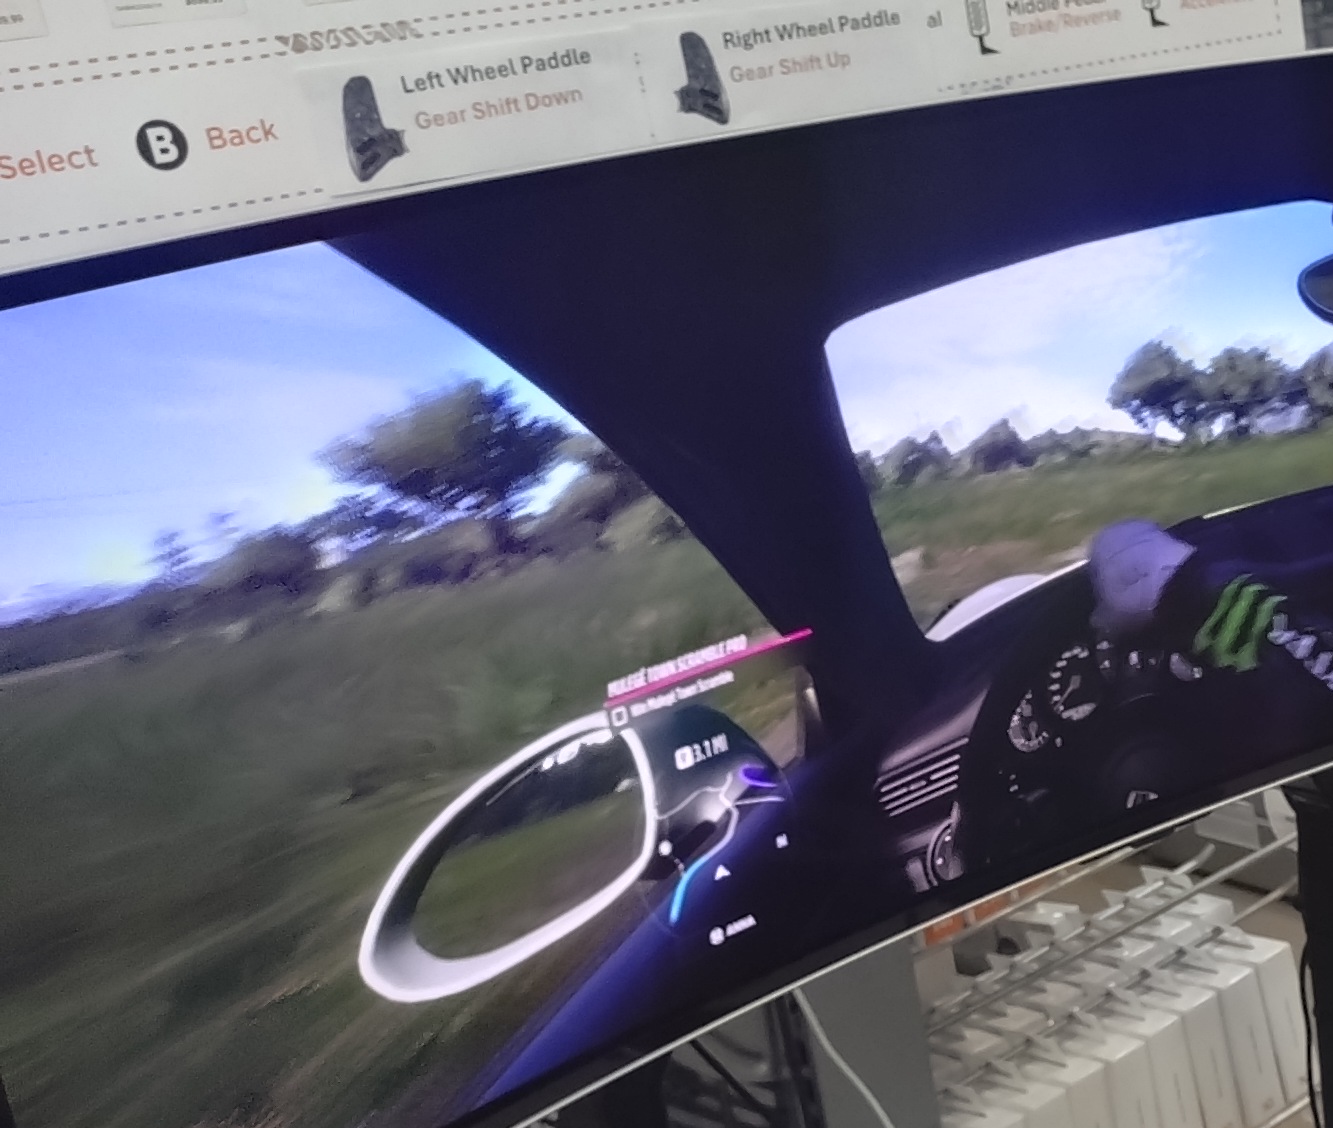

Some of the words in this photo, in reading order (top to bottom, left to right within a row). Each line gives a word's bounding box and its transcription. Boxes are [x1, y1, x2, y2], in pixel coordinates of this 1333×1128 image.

[721, 28, 772, 51] Right
[774, 17, 836, 42] Wheel
[838, 9, 901, 33] Paddle
[400, 71, 445, 94] Left
[446, 58, 519, 86] Wheel
[519, 48, 593, 75] Paddle
[730, 64, 774, 83] Gear
[779, 55, 823, 76] Shift
[825, 52, 852, 70] Up
[415, 108, 467, 130] Gear
[471, 96, 522, 121] Shift
[524, 88, 584, 112] Down
[0, 144, 98, 180] Select
[143, 122, 182, 167] B
[205, 118, 279, 151] Back
